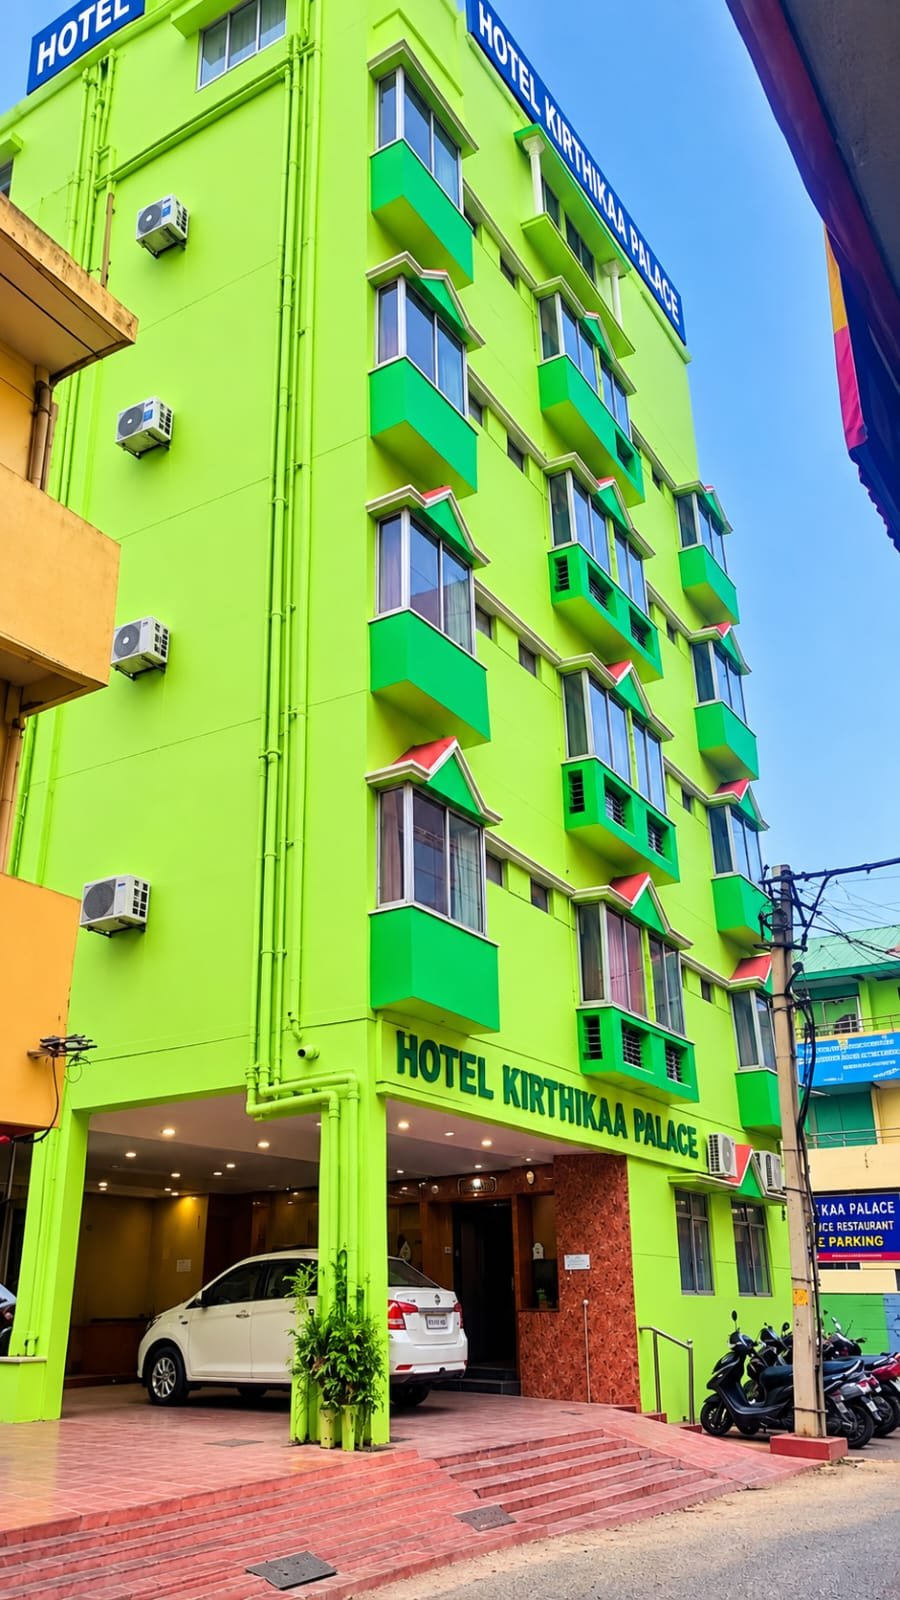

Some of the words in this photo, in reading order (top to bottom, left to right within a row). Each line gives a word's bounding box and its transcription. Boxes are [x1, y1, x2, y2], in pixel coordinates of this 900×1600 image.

[36, 0, 130, 76] HOTEL
[479, 1, 541, 116] HOTEL
[544, 95, 628, 244] KIRTHIKAA
[629, 224, 680, 325] PALACE
[396, 1030, 494, 1100] HOTEL
[502, 1064, 628, 1140] KIRTHIKAA
[632, 1107, 699, 1159] PALACE
[837, 1220, 895, 1232] RESTAURANT
[849, 1201, 895, 1215] PALACE
[828, 1235, 884, 1247] PARKING
